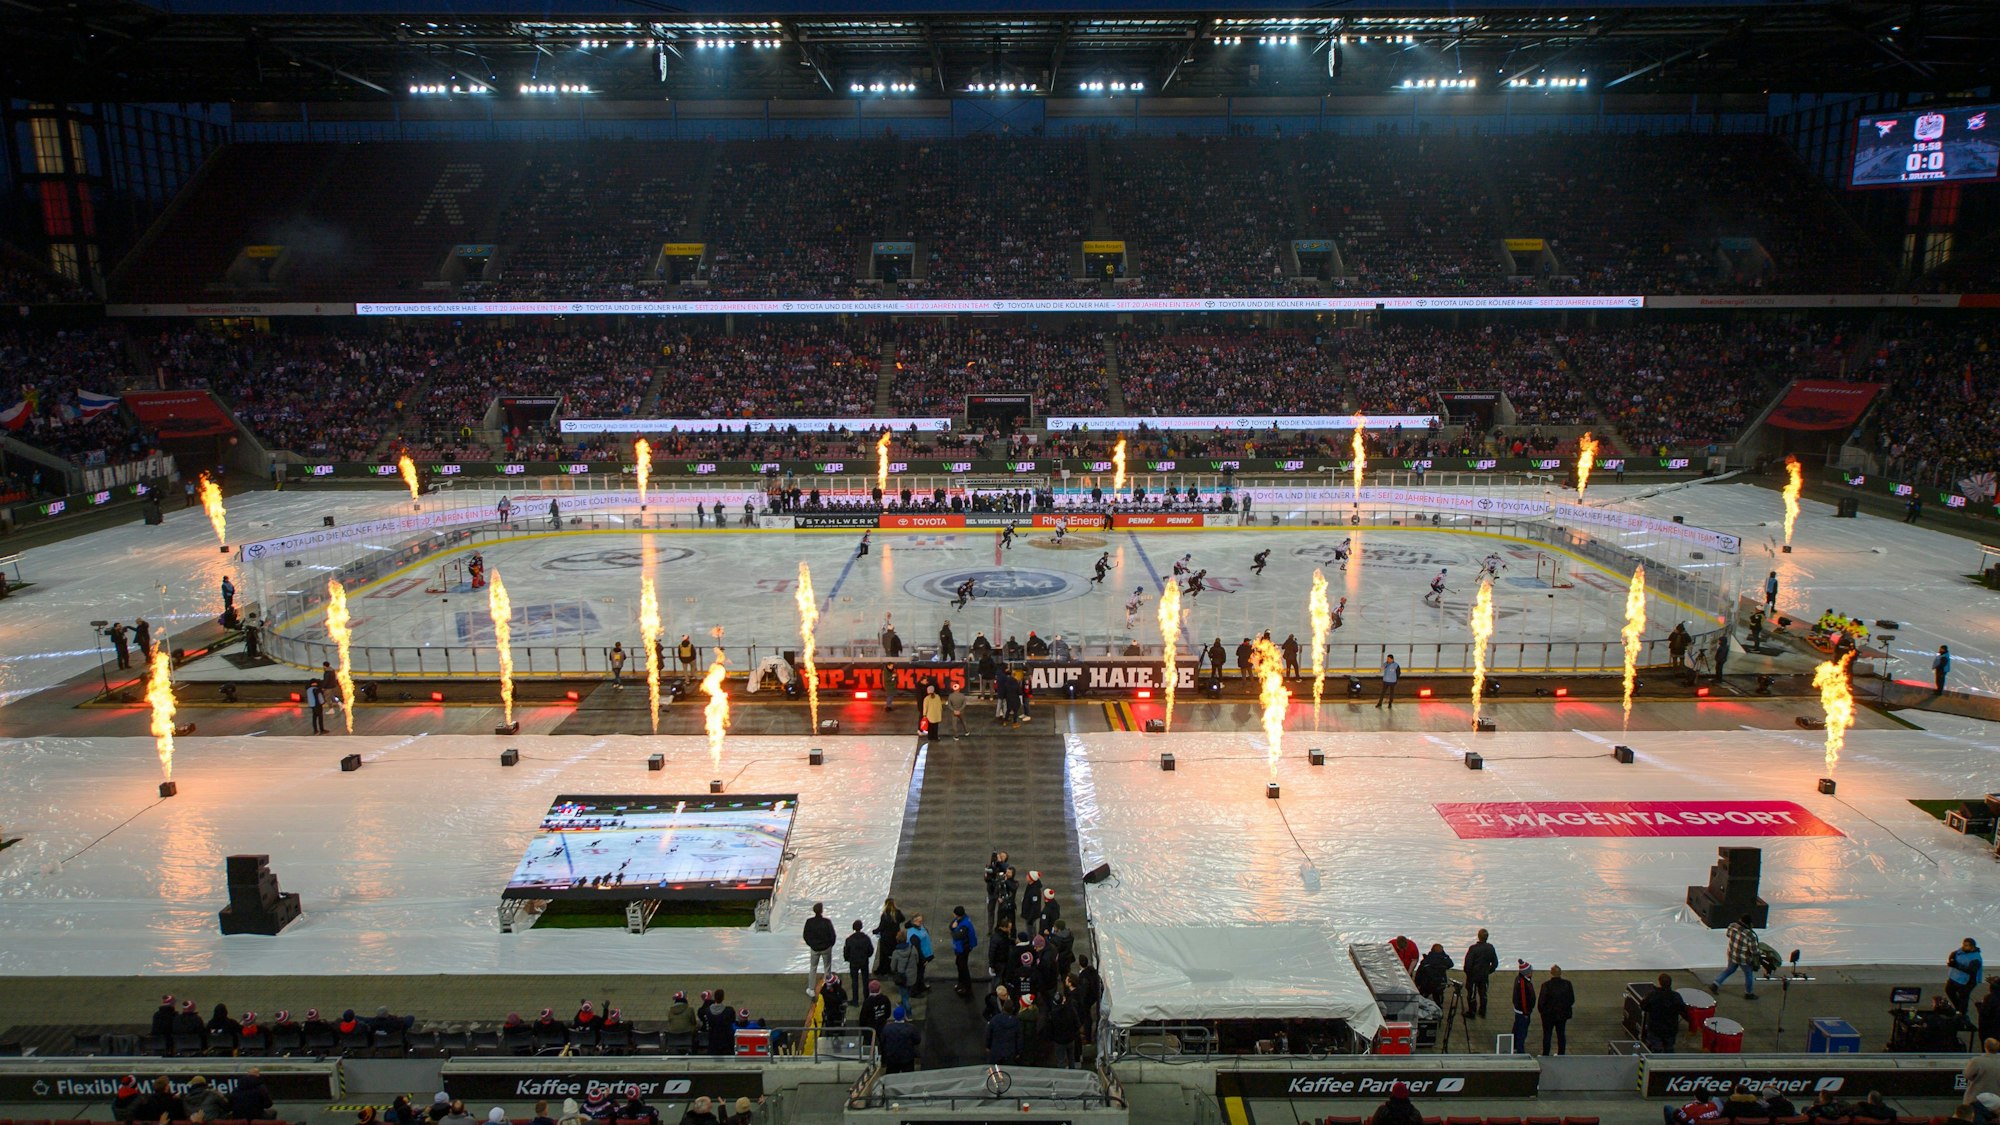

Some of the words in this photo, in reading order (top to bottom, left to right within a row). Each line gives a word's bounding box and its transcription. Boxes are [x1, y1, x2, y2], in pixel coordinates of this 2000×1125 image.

[1906, 152, 1945, 171] 0:0
[1497, 502, 1530, 511] TOYOTA
[1032, 667, 1082, 689] AUF
[1499, 812, 1683, 826] MAGENTA
[1678, 811, 1796, 825] SPORT
[516, 1078, 582, 1095] Kaffee
[1288, 1077, 1354, 1093] Kaffee
[1666, 1076, 1732, 1092] Kaffee
